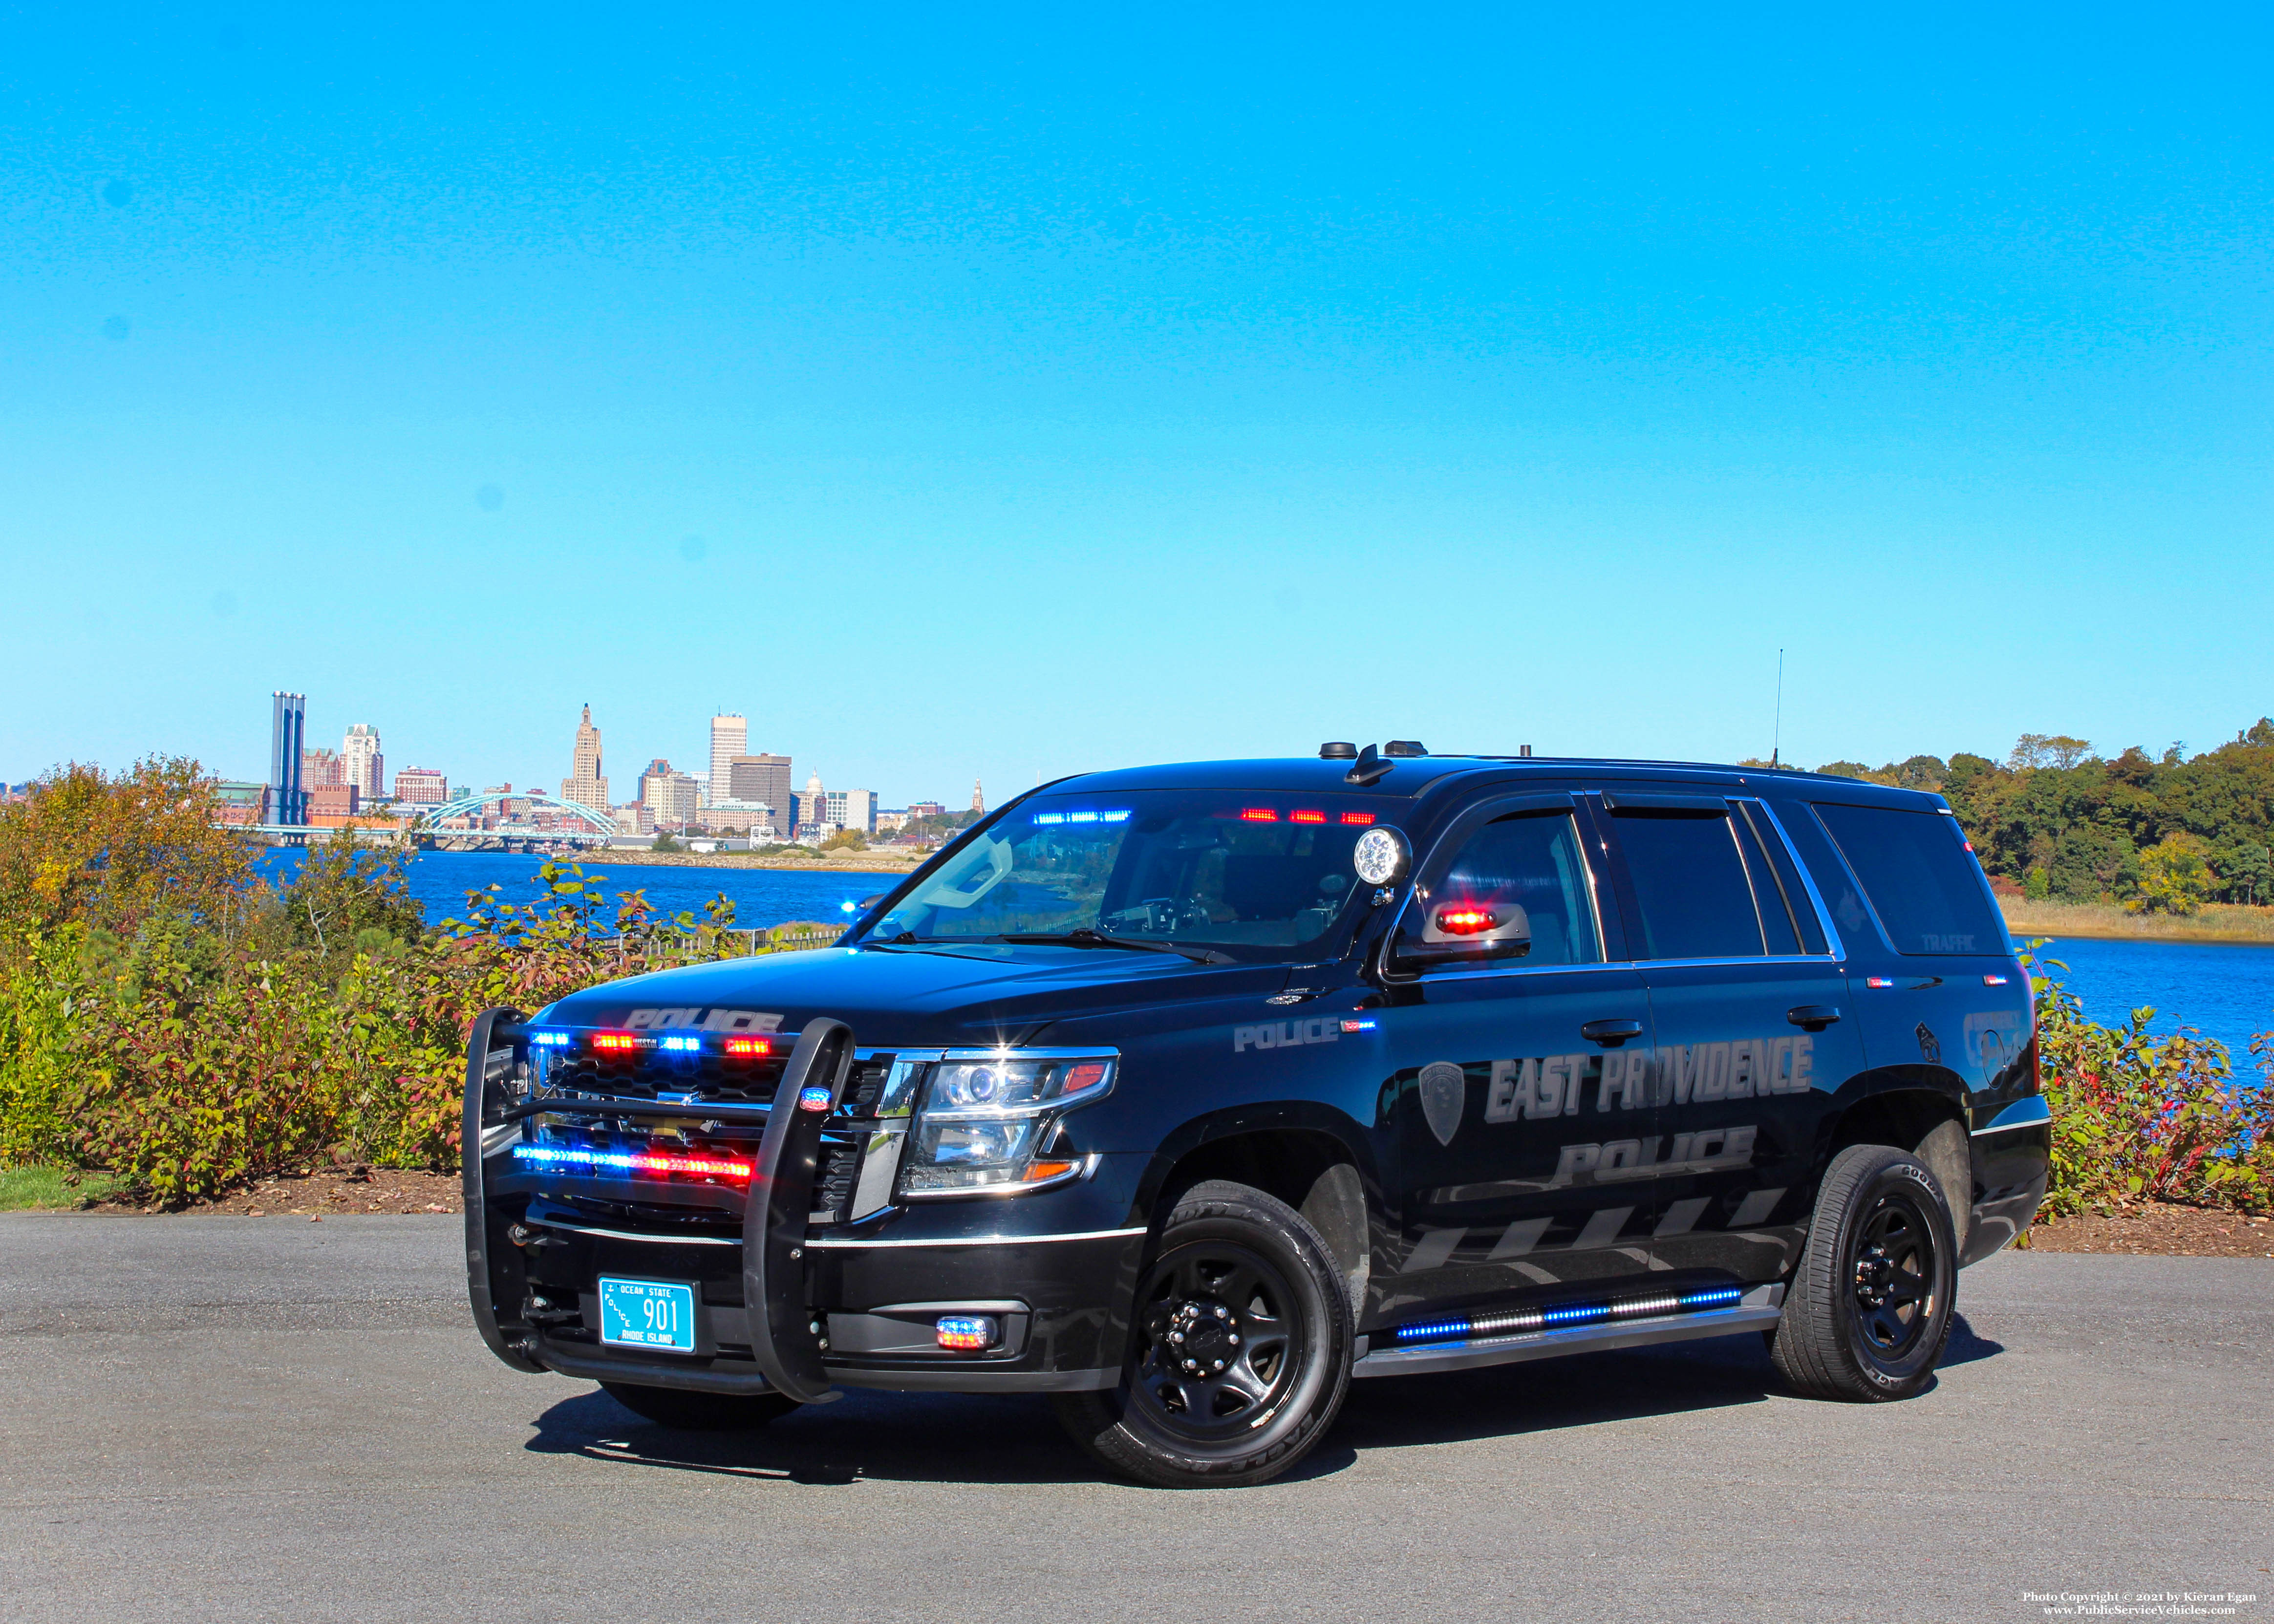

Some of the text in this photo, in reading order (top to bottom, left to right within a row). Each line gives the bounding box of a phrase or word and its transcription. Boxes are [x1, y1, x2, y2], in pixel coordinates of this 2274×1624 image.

[1922, 935, 1975, 951] TRAFFIC
[623, 1008, 784, 1033] POLICE
[1234, 1017, 1338, 1052] POLICE
[1484, 1053, 1590, 1123] EAST
[1596, 1035, 1813, 1112] PROVIDENCE
[1550, 1125, 1758, 1186] POLICE
[621, 1285, 671, 1298] OCEAN STATE
[605, 1294, 630, 1327] POLICE
[644, 1299, 677, 1331] 901
[622, 1329, 672, 1343] RHODE ISLAND
